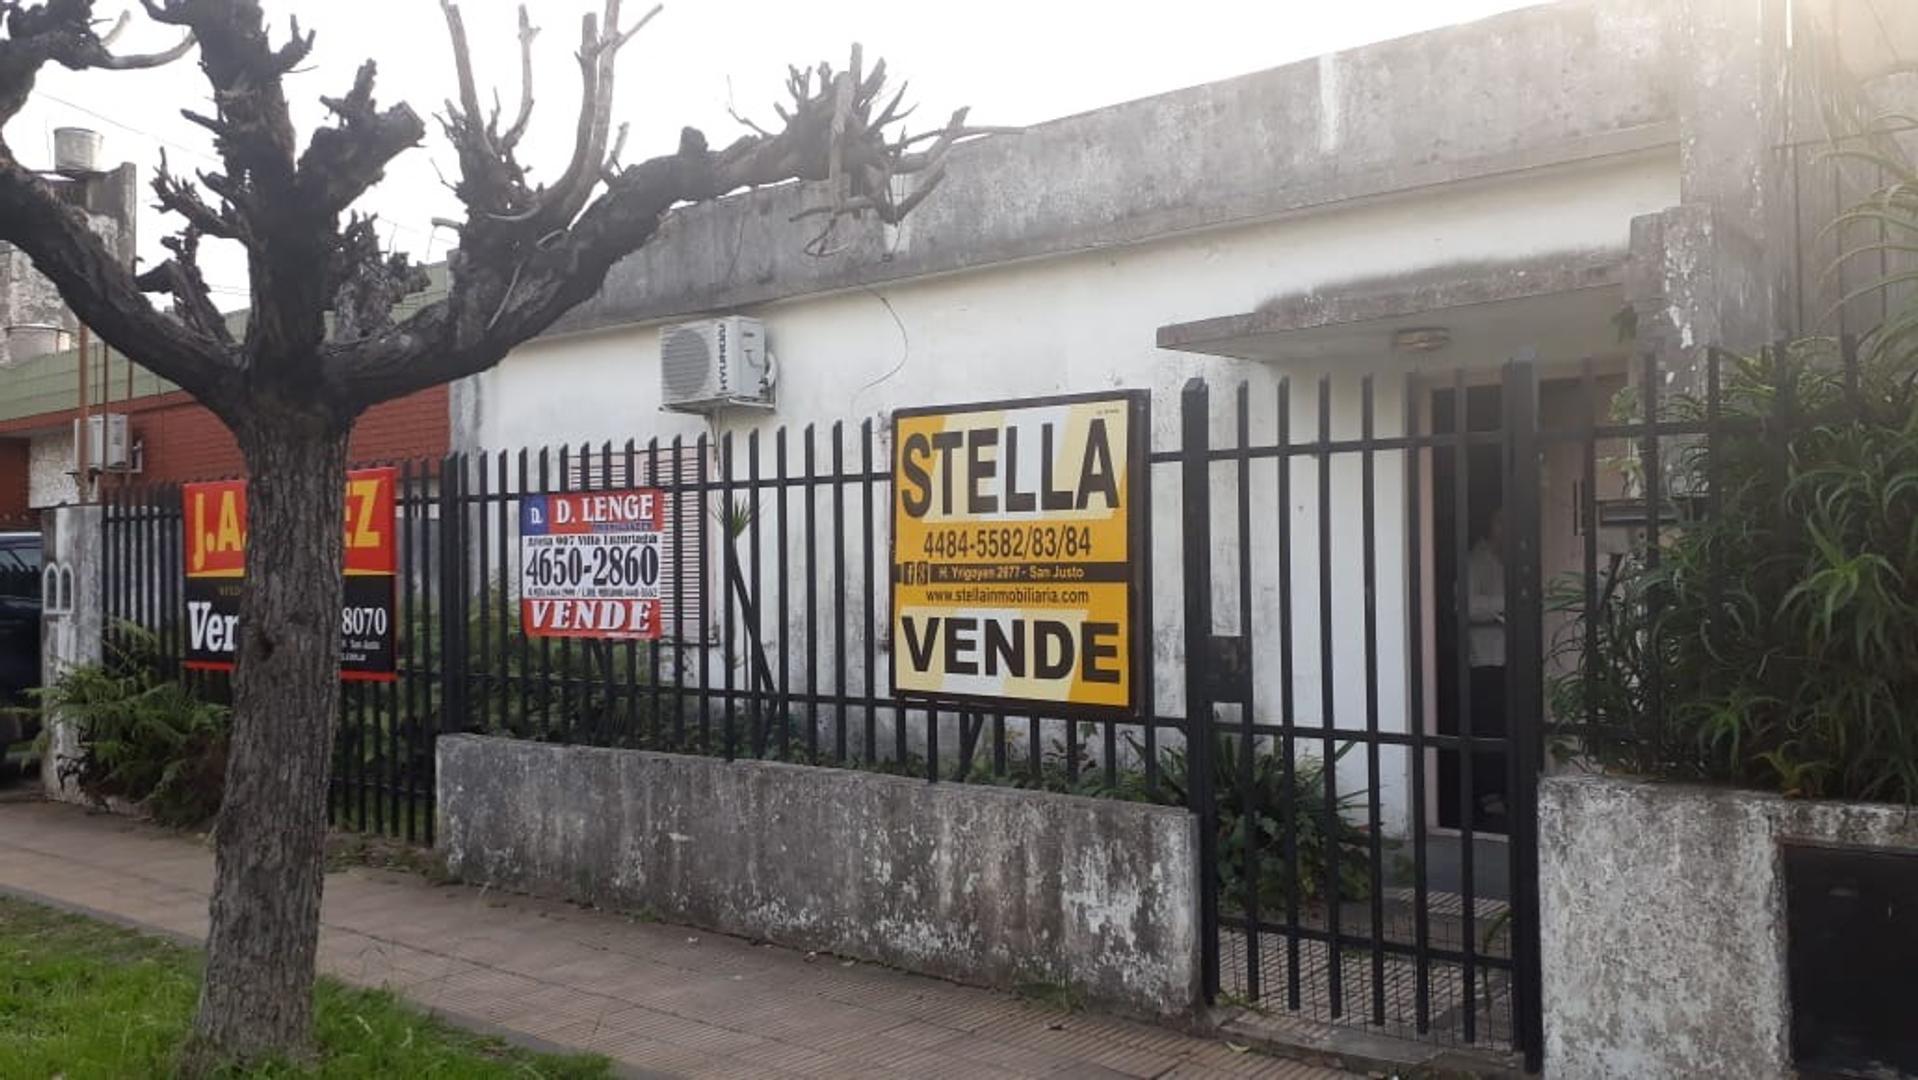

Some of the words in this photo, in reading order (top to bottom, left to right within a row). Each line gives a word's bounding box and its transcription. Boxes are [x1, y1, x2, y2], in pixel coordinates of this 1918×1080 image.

[718, 323, 727, 391] HYUNDAI
[901, 418, 1121, 518] STELLA
[556, 499, 576, 523] D.
[582, 494, 653, 522] LENGE
[923, 526, 1092, 559] 4484-5582/83/84
[526, 546, 659, 586] 4650-2860
[1029, 565, 1050, 579] San
[1054, 565, 1085, 579] Justo
[926, 586, 1090, 604] www.stellainmobiliaria.com
[342, 607, 387, 635] 8070
[531, 600, 652, 631] VENDE
[901, 616, 1121, 684] VENDE
